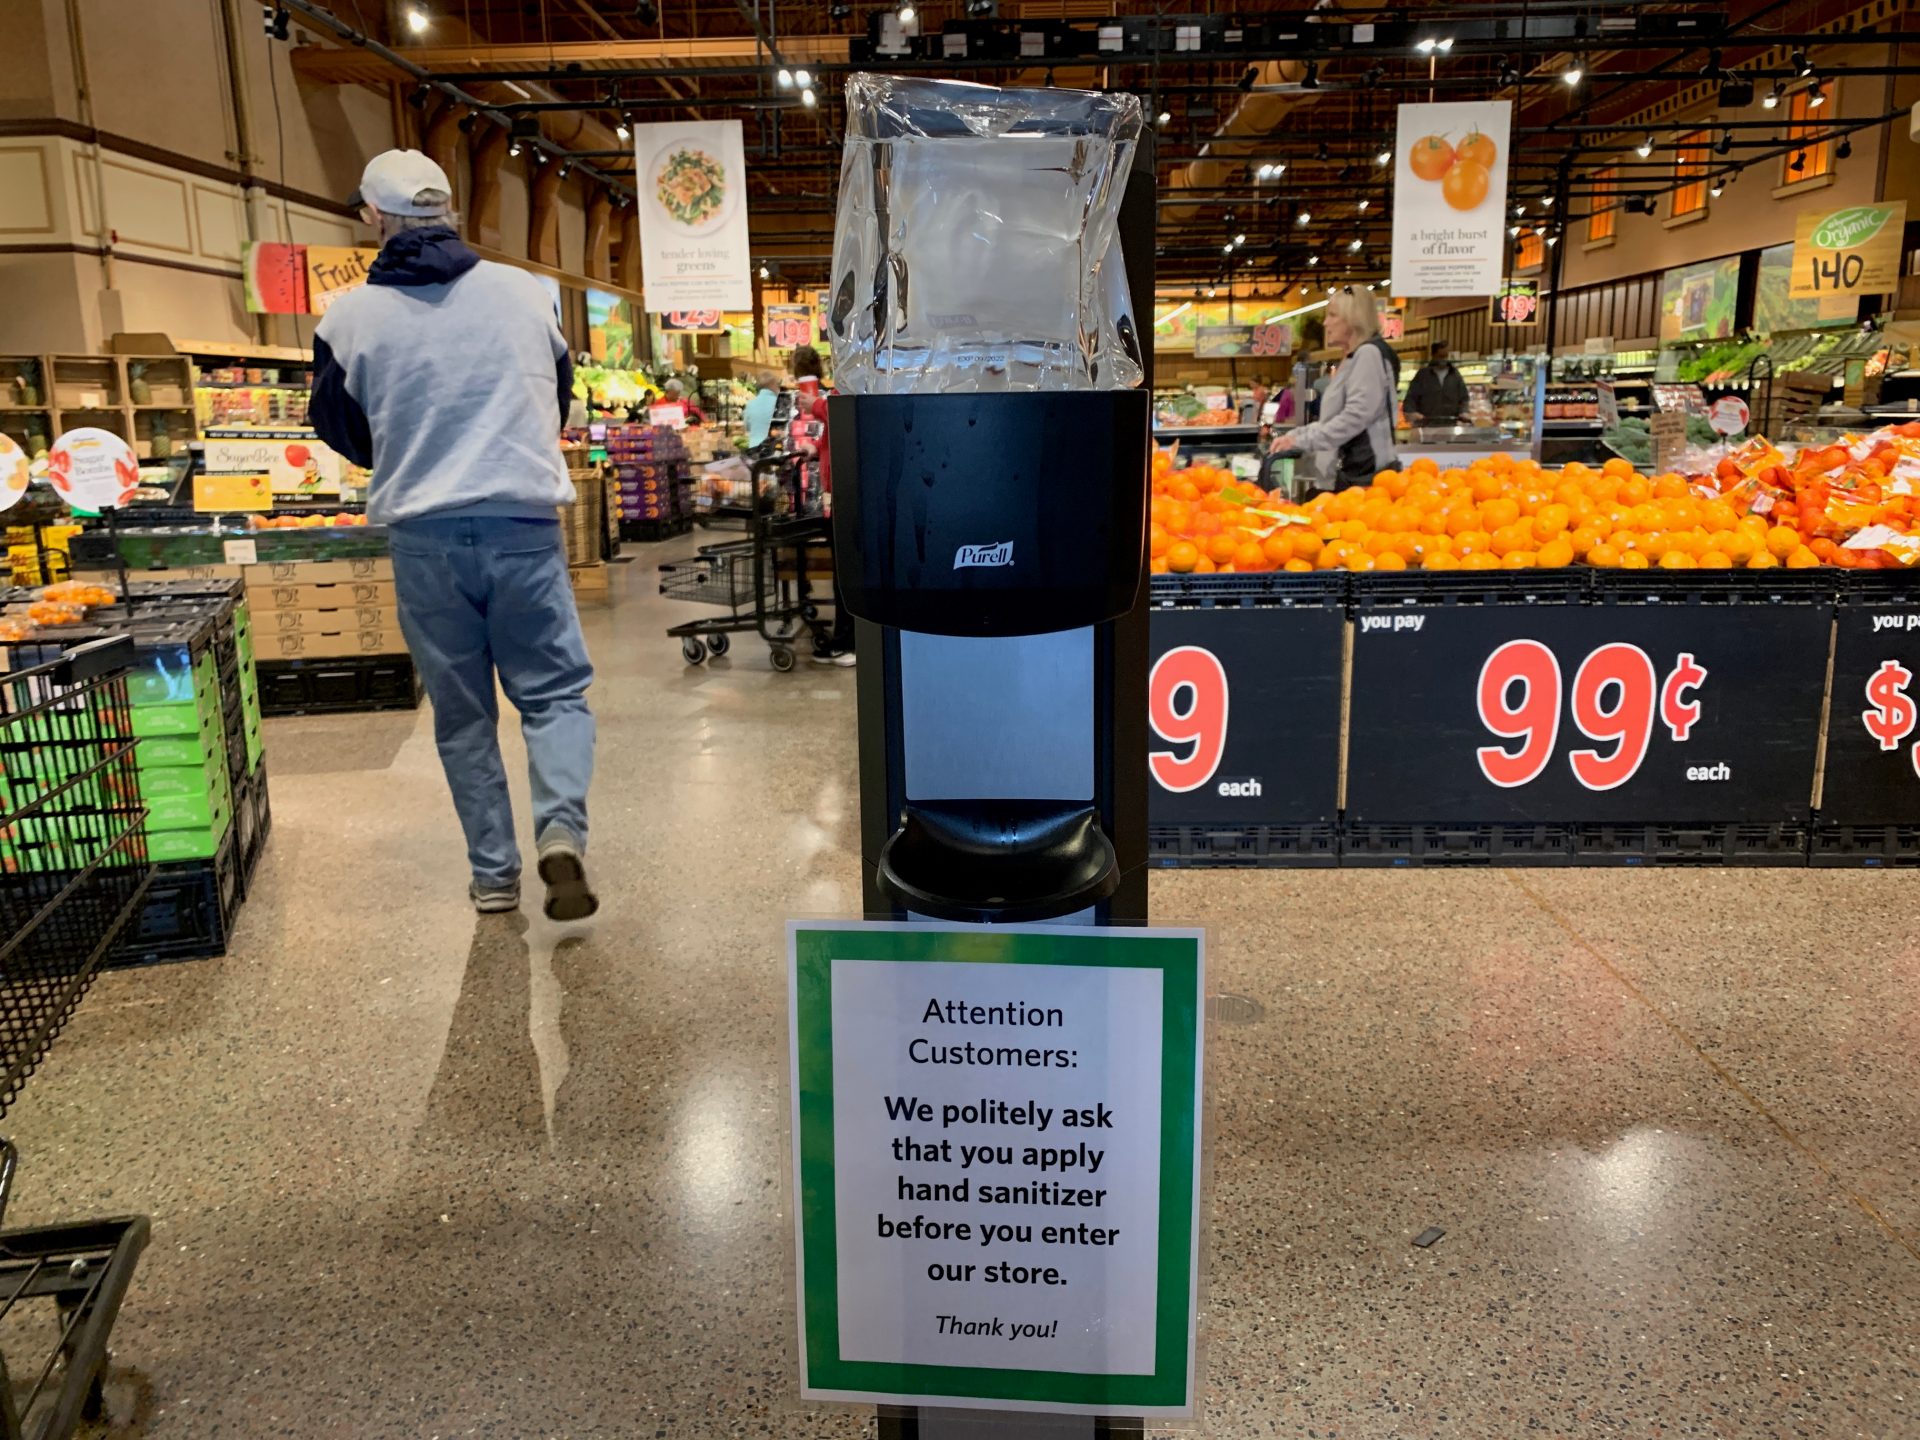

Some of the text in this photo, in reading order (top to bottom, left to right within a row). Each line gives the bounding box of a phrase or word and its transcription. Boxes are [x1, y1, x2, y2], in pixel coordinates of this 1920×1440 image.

[1421, 230, 1454, 243] bright
[1458, 229, 1487, 240] burst
[1816, 210, 1879, 247] Organic
[660, 247, 731, 261] tender loving
[1437, 242, 1475, 255] flavor
[313, 251, 369, 291] Fruit
[676, 262, 716, 274] greens
[1812, 252, 1864, 290] 140
[959, 546, 1009, 565] Purell
[1361, 614, 1425, 632] you pay
[1873, 614, 1920, 632] you p
[1686, 762, 1731, 782] each
[1218, 778, 1262, 798] each
[922, 998, 1064, 1027] Attention
[908, 1038, 1078, 1069] Customers:
[884, 1096, 1114, 1132] We politely ask
[892, 1136, 1105, 1174] that you apply
[898, 1176, 1108, 1208] hand sanitizer
[877, 1213, 1121, 1247] before you enter
[927, 1261, 1068, 1286] our store.
[936, 1315, 1059, 1340] Thank you!
